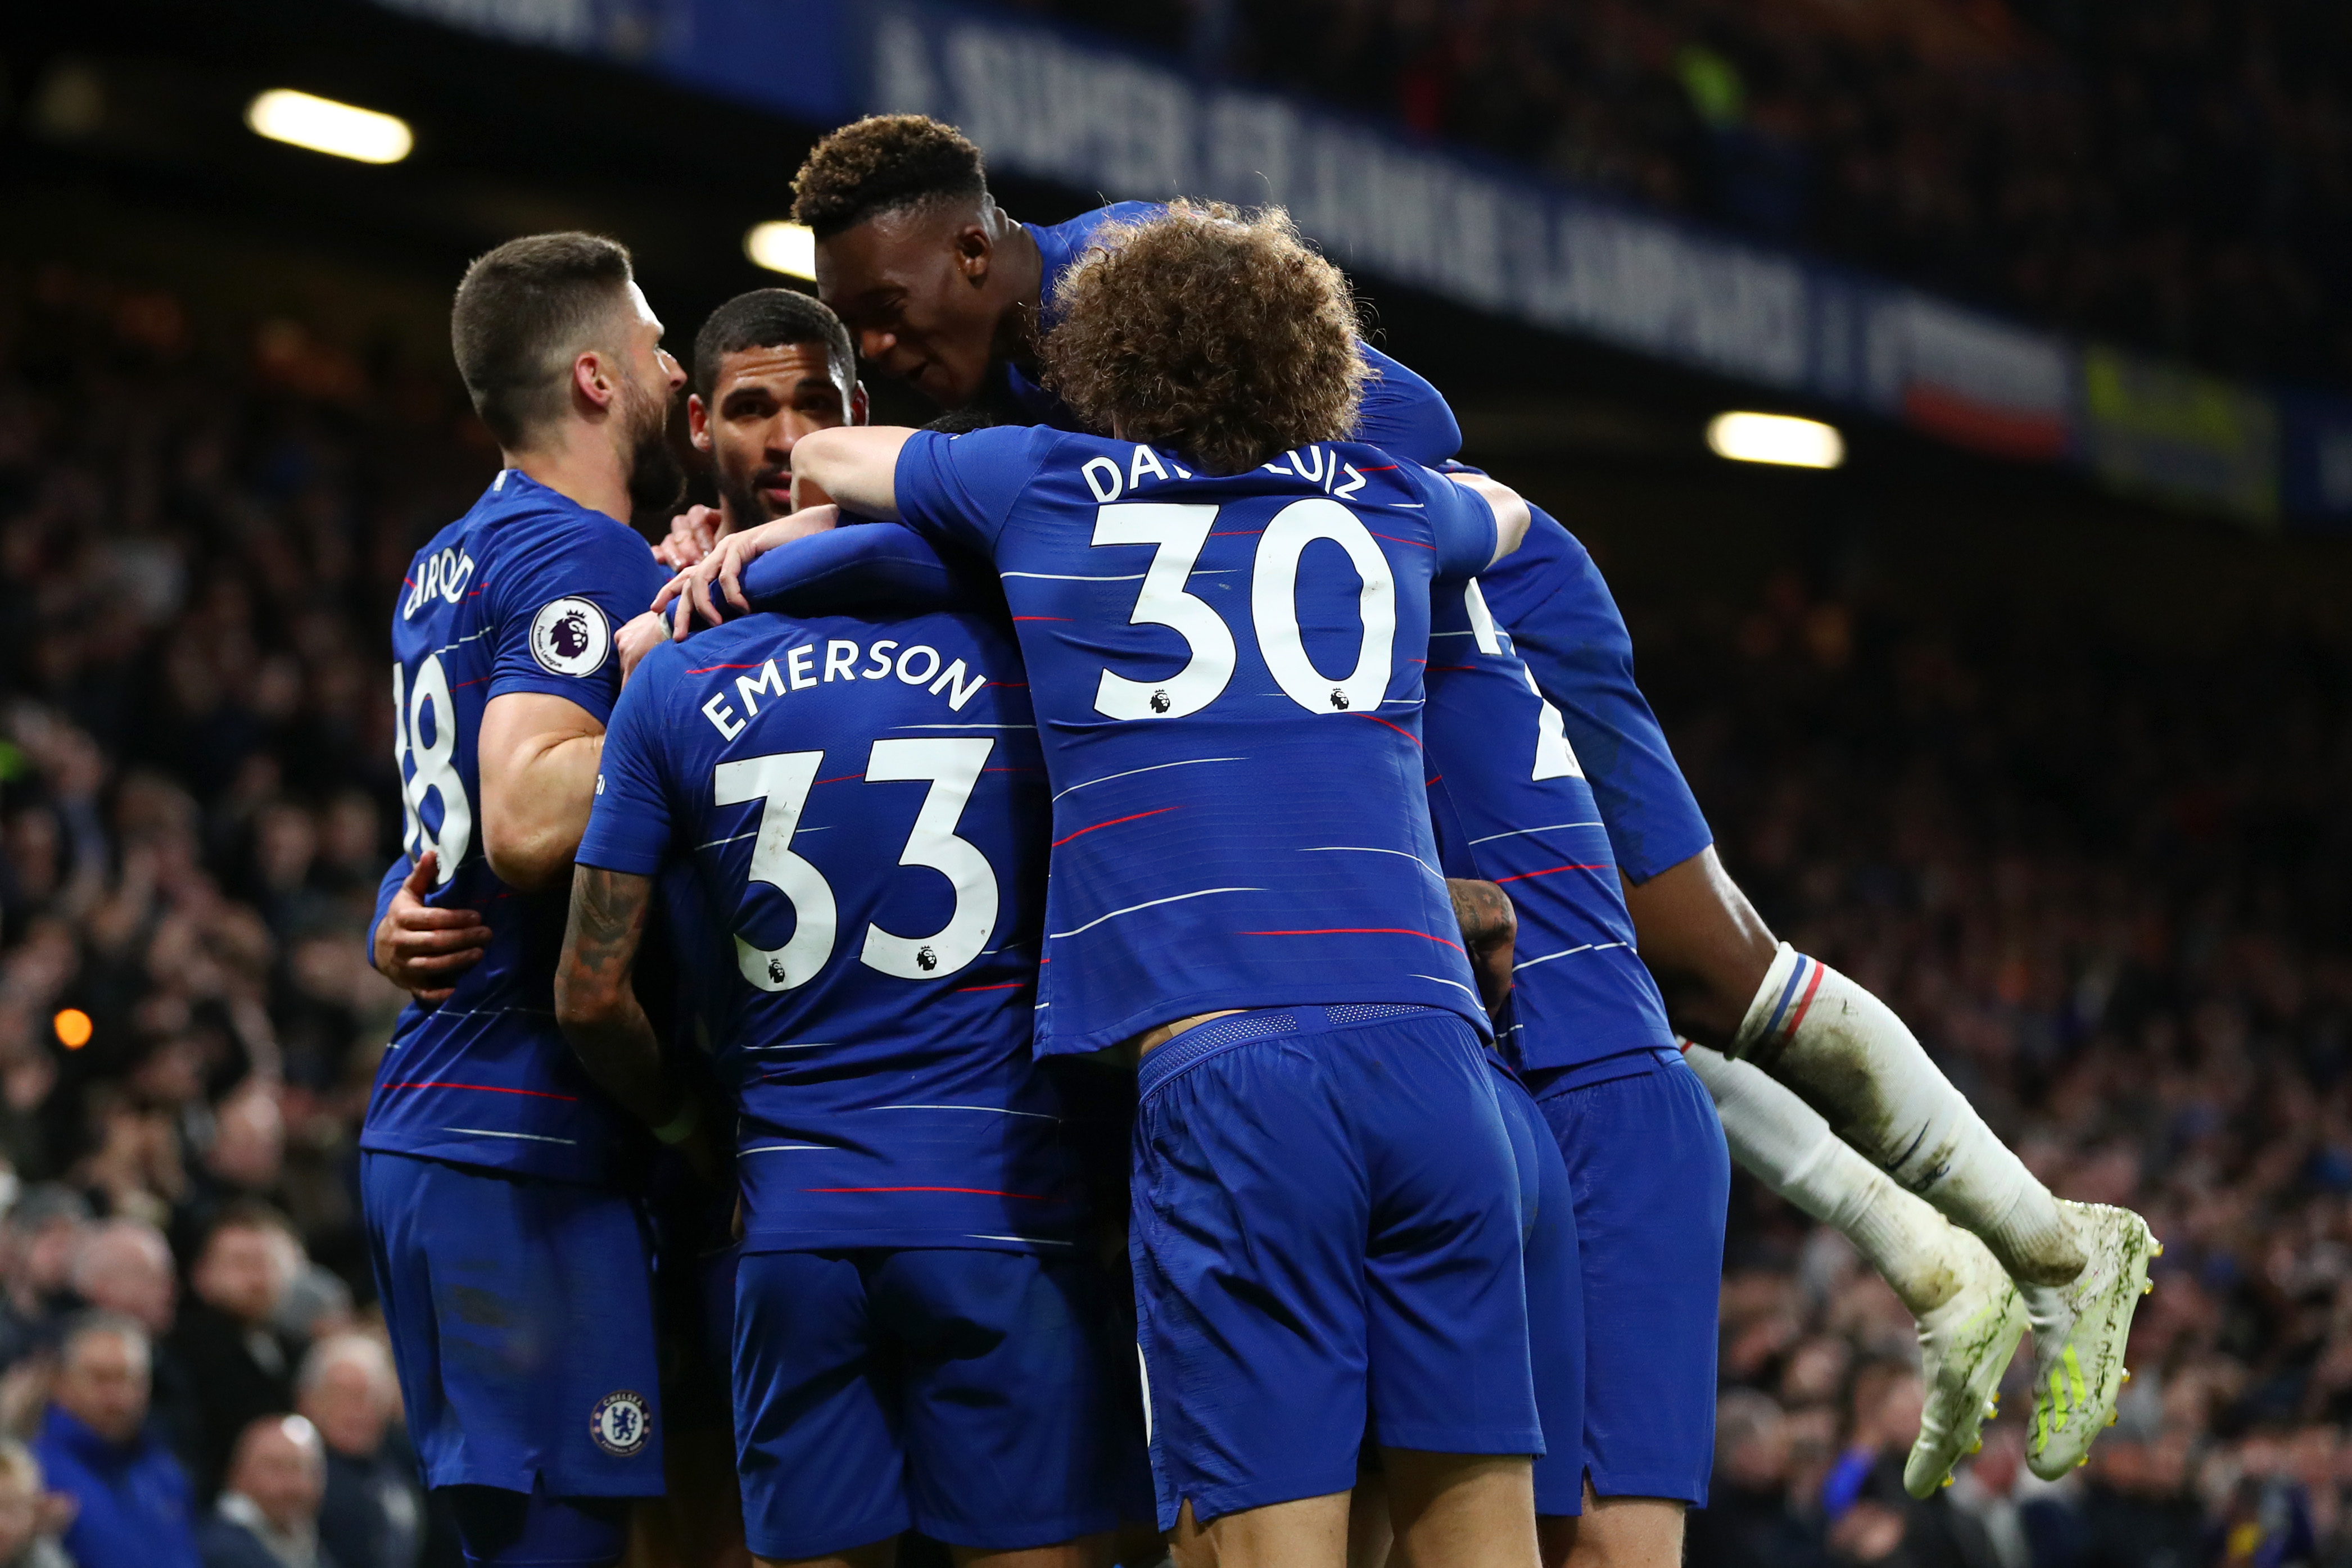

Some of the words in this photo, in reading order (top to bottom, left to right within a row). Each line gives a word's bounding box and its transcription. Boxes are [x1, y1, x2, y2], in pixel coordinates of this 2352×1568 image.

[541, 650, 562, 668] League
[701, 639, 987, 742] EMERSON
[1089, 498, 1396, 720] 30
[392, 652, 472, 885] 18
[714, 737, 999, 992] 33
